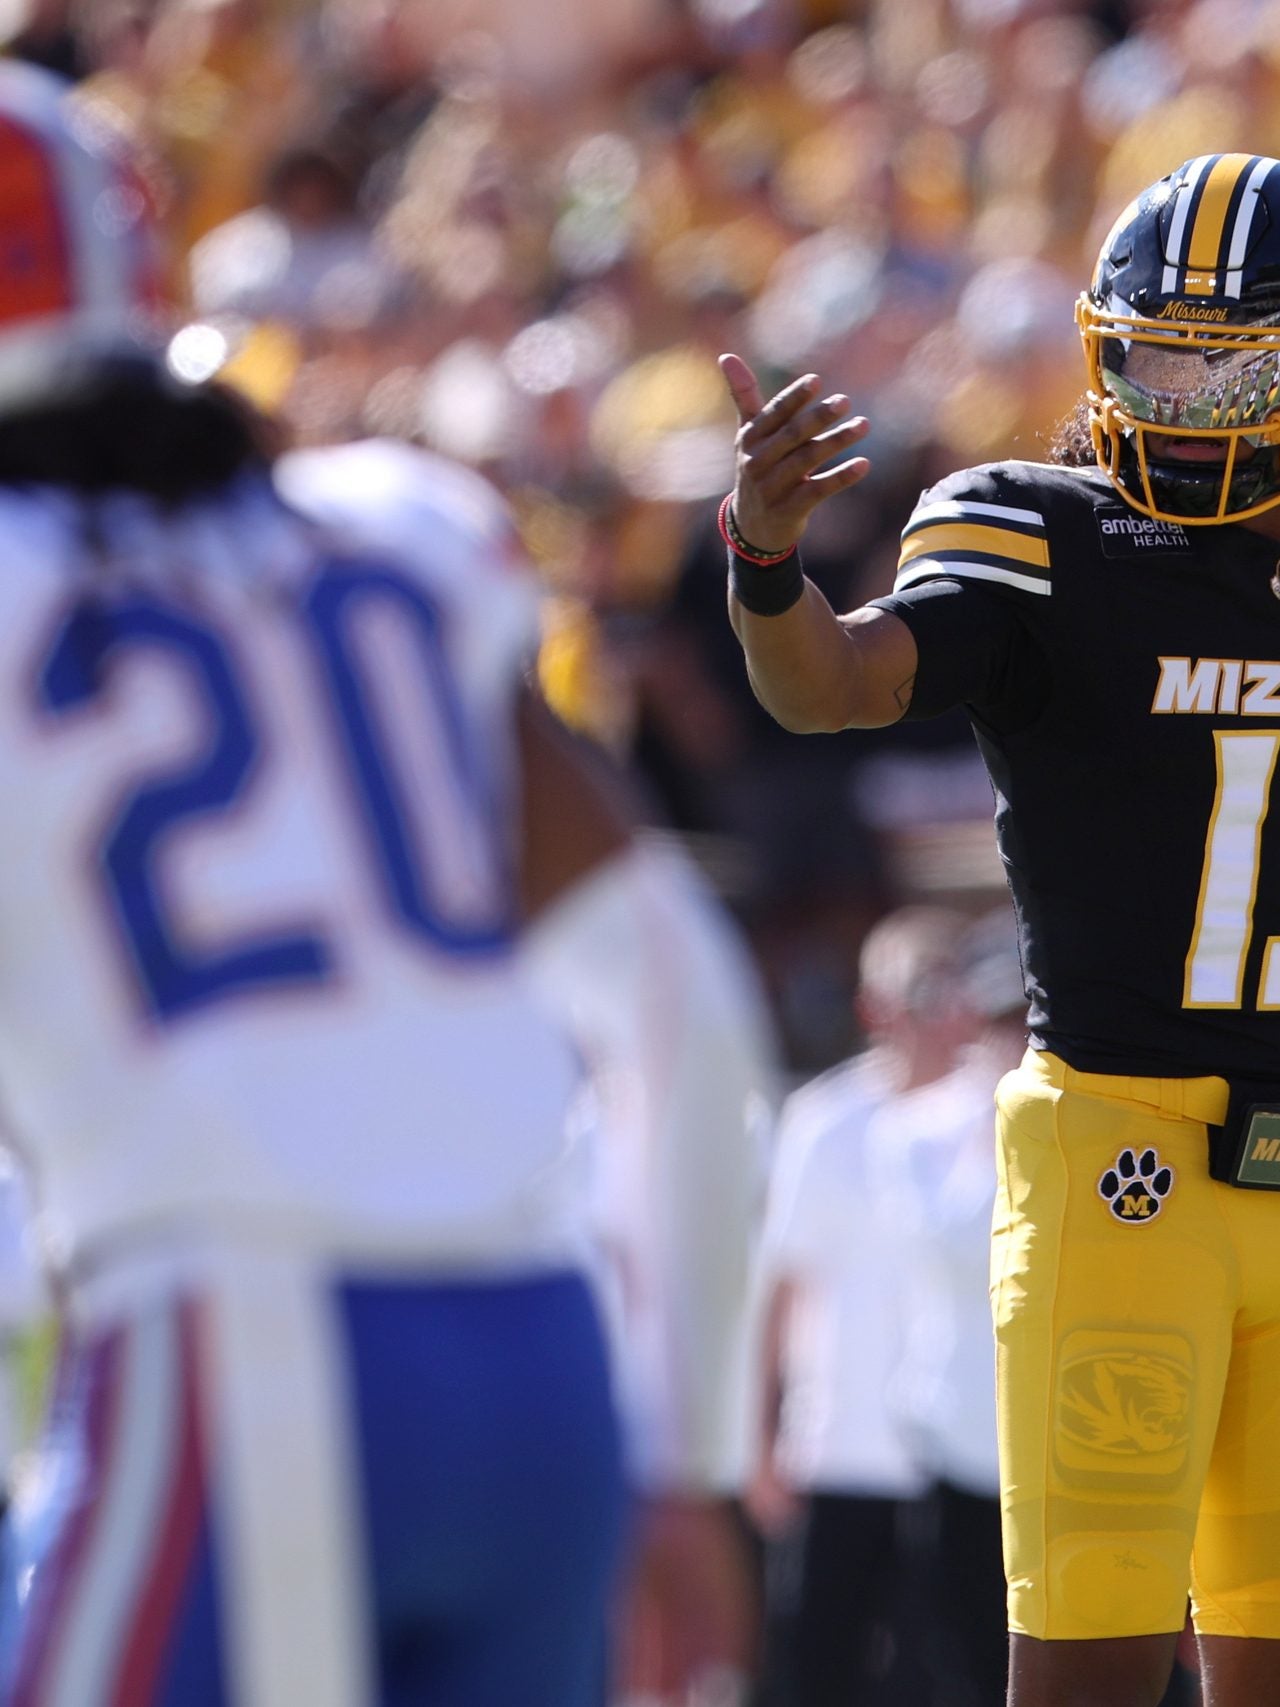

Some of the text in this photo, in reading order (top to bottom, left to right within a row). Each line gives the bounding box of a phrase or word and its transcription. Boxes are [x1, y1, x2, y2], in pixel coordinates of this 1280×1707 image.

[1156, 300, 1228, 322] Missouri
[1133, 534, 1190, 547] HEALTH
[38, 555, 526, 1025] 20
[1121, 1194, 1151, 1216] M
